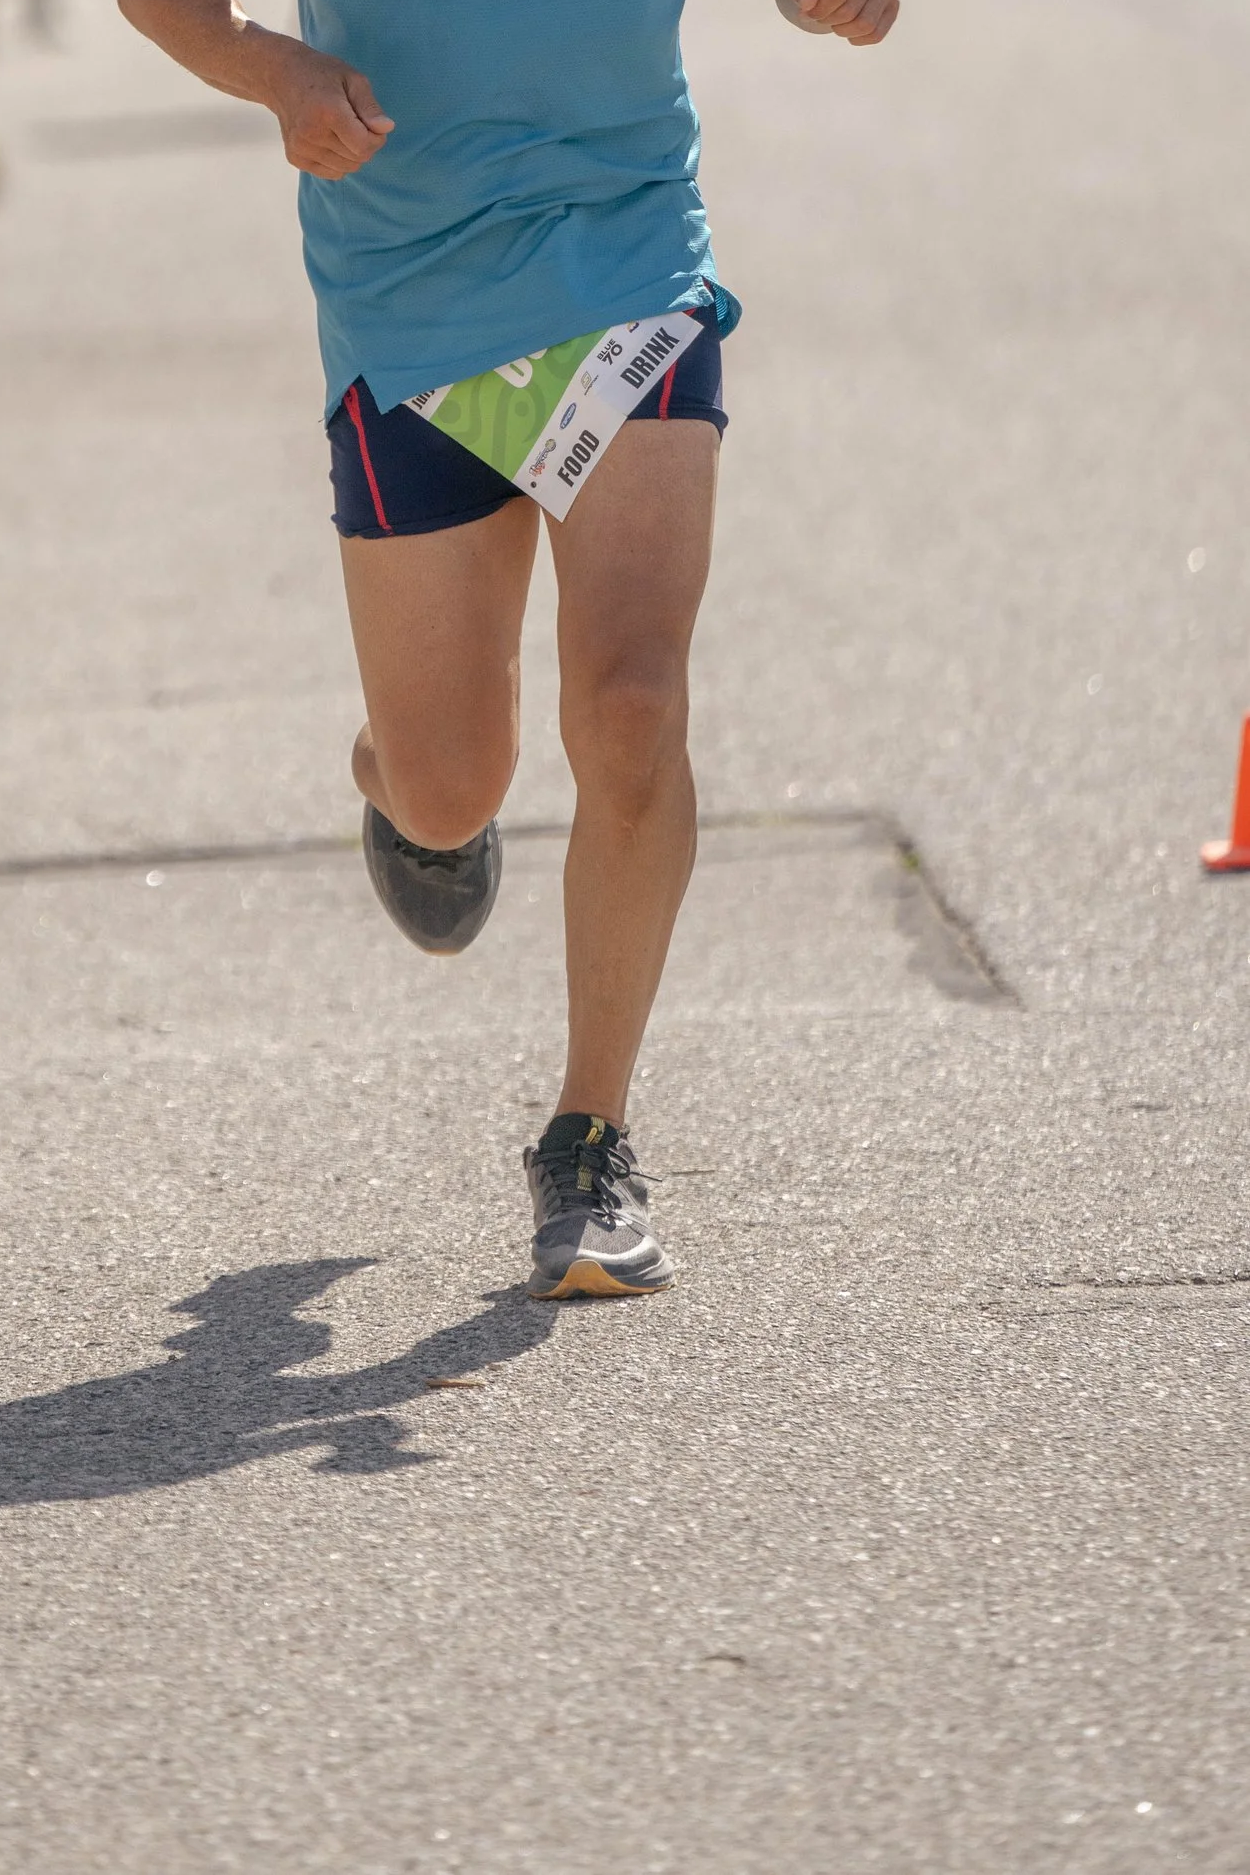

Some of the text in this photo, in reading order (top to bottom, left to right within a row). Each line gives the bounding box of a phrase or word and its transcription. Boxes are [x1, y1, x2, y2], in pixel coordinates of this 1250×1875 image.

[596, 338, 616, 360] BLUE
[601, 343, 623, 365] 70
[620, 326, 680, 389] DRINK
[557, 430, 600, 488] FOOD
